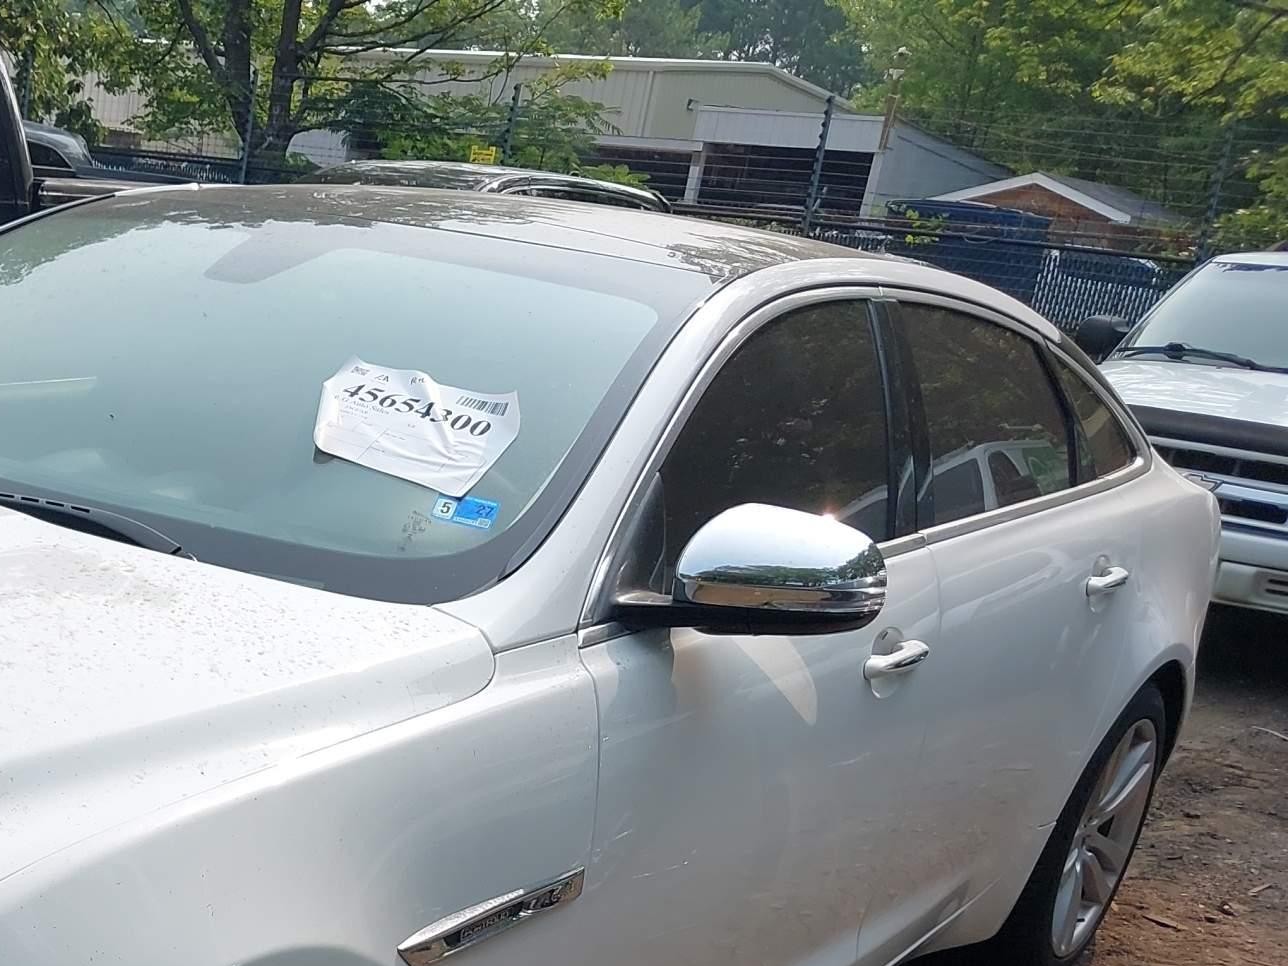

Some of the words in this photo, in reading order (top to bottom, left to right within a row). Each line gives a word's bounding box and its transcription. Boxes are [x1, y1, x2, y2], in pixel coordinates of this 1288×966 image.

[343, 384, 492, 436] 45654300
[440, 501, 452, 514] 5
[475, 504, 497, 517] 27
